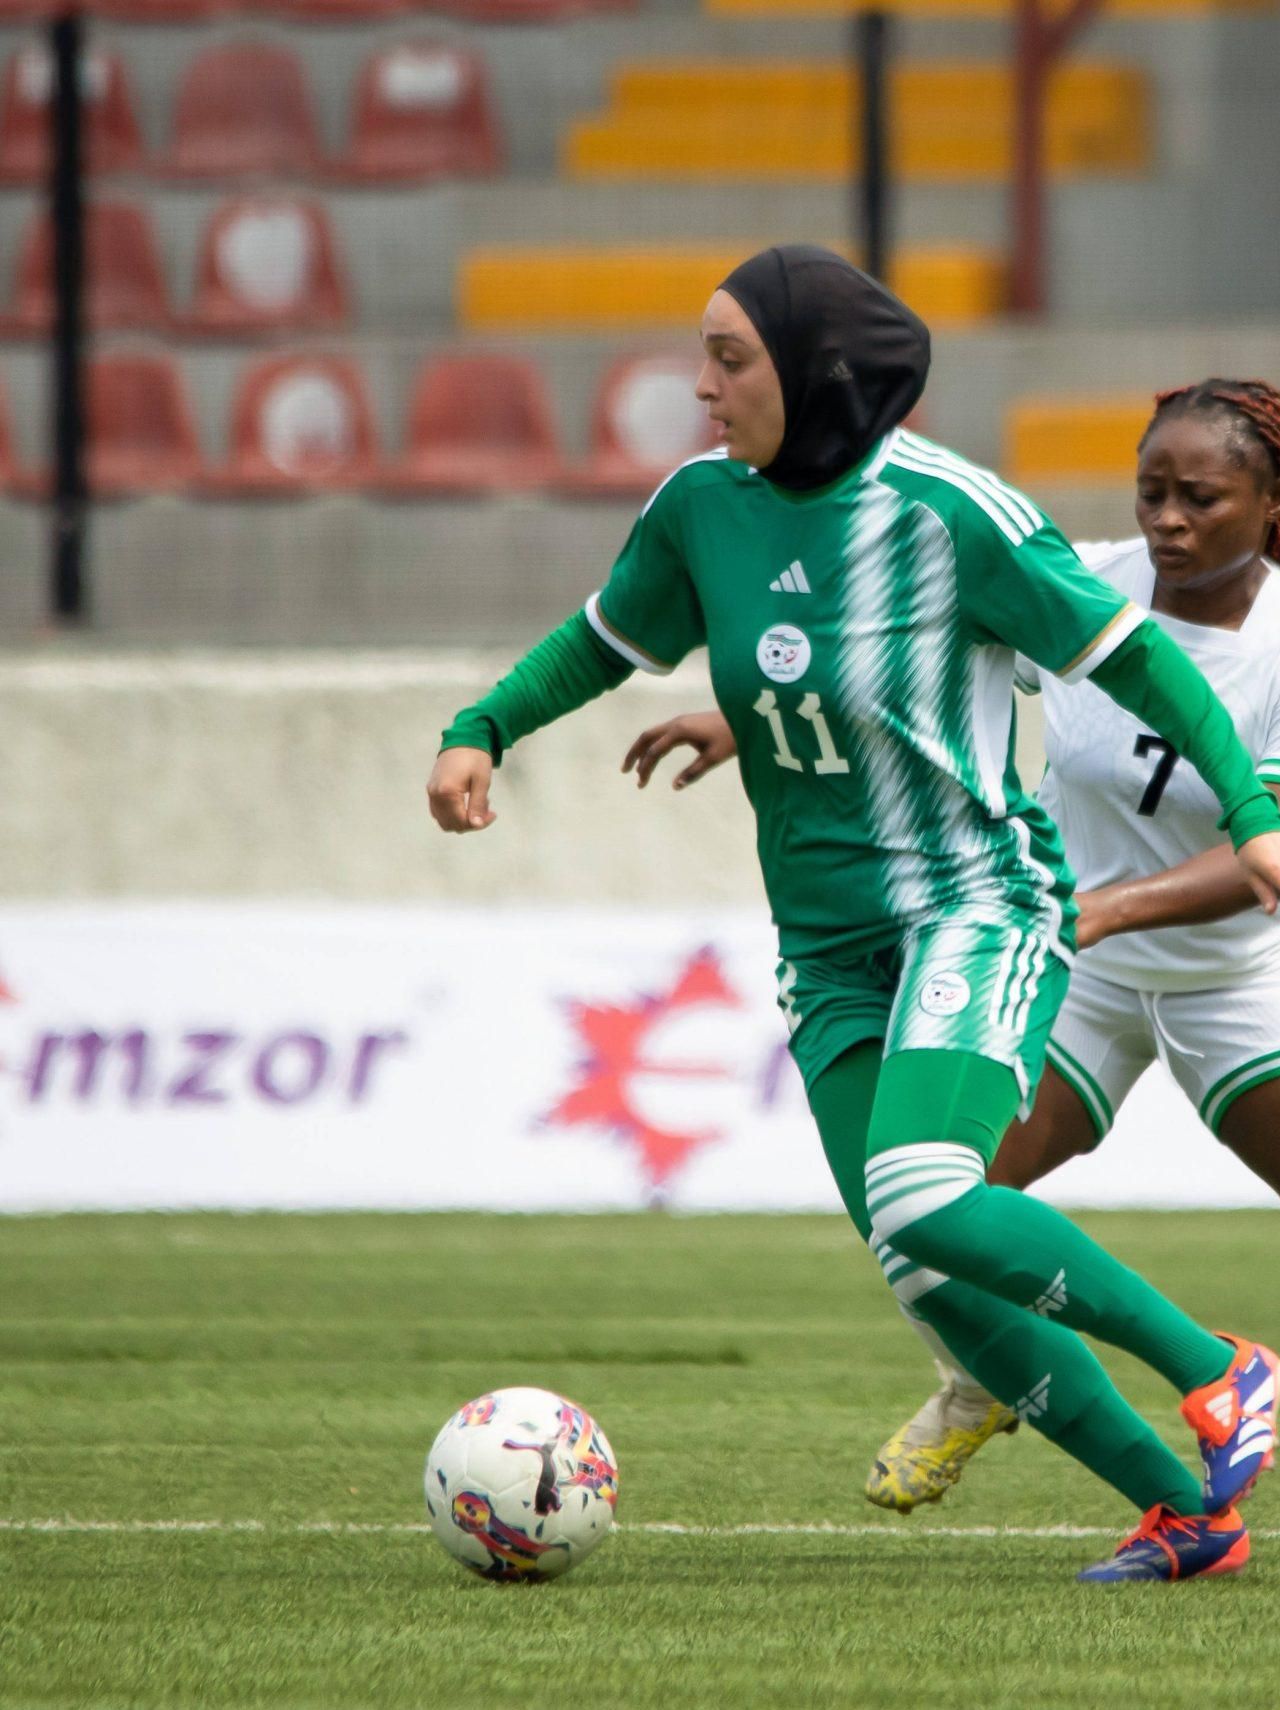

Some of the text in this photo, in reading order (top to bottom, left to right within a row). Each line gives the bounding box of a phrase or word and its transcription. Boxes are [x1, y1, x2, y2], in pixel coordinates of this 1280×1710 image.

[753, 689, 850, 775] 11
[1133, 733, 1180, 817] 7
[8, 1028, 408, 1105] mzor
